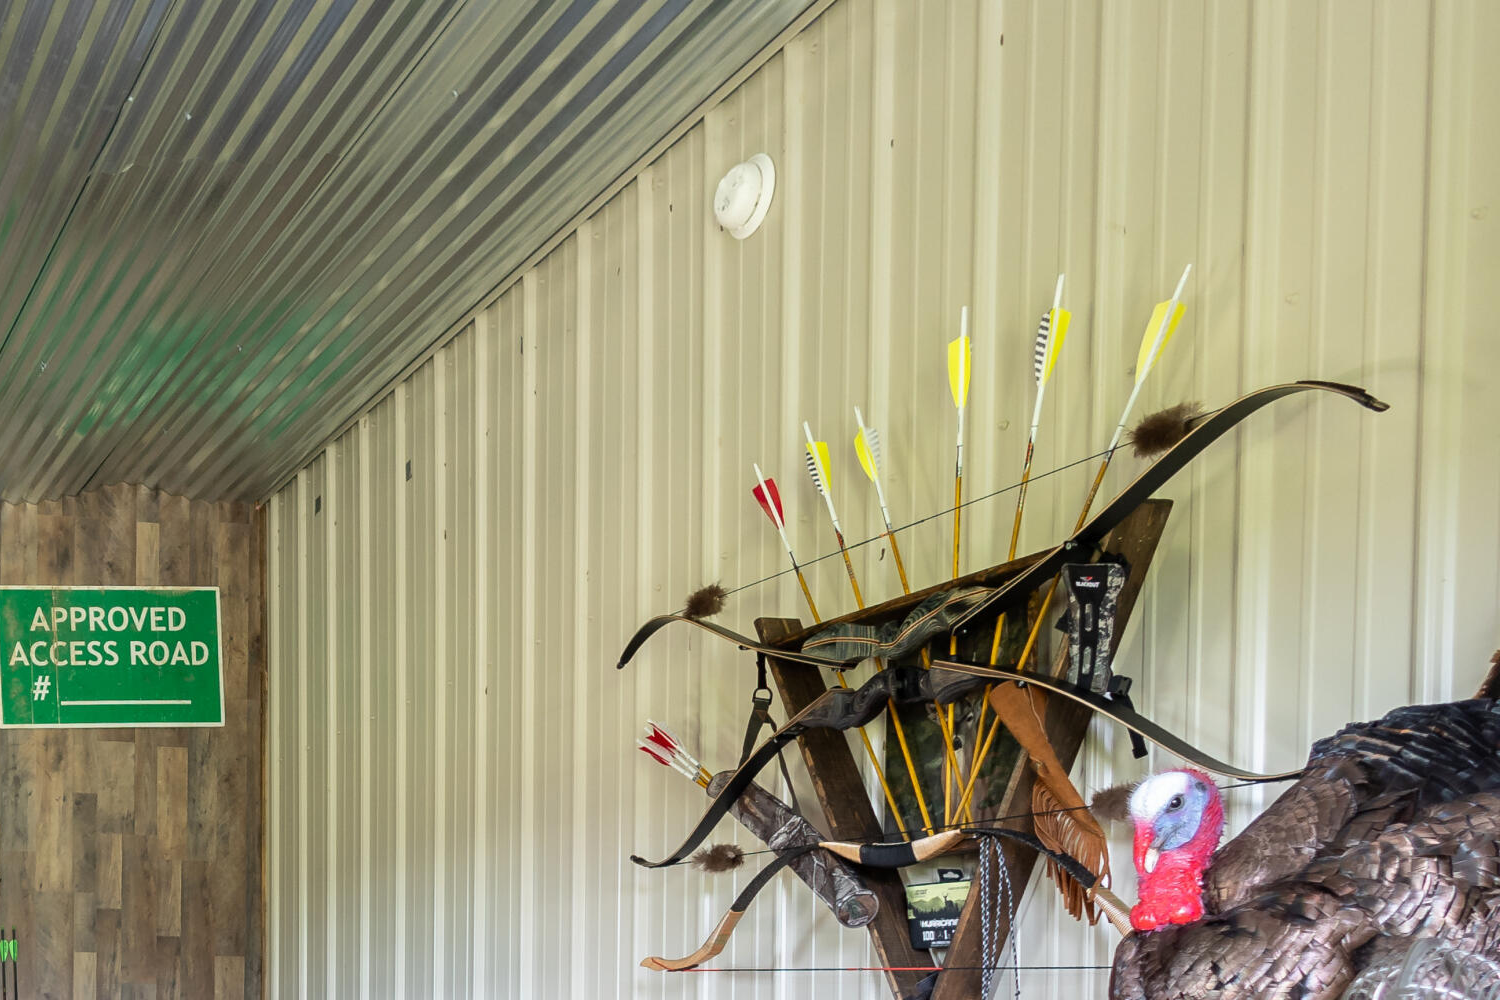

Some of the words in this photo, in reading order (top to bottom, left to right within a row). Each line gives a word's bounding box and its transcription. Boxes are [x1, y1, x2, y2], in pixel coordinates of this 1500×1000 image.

[29, 606, 187, 632] APPROVED
[8, 641, 120, 666] ACCESS
[130, 641, 209, 666] ROAD
[32, 675, 51, 701] #
